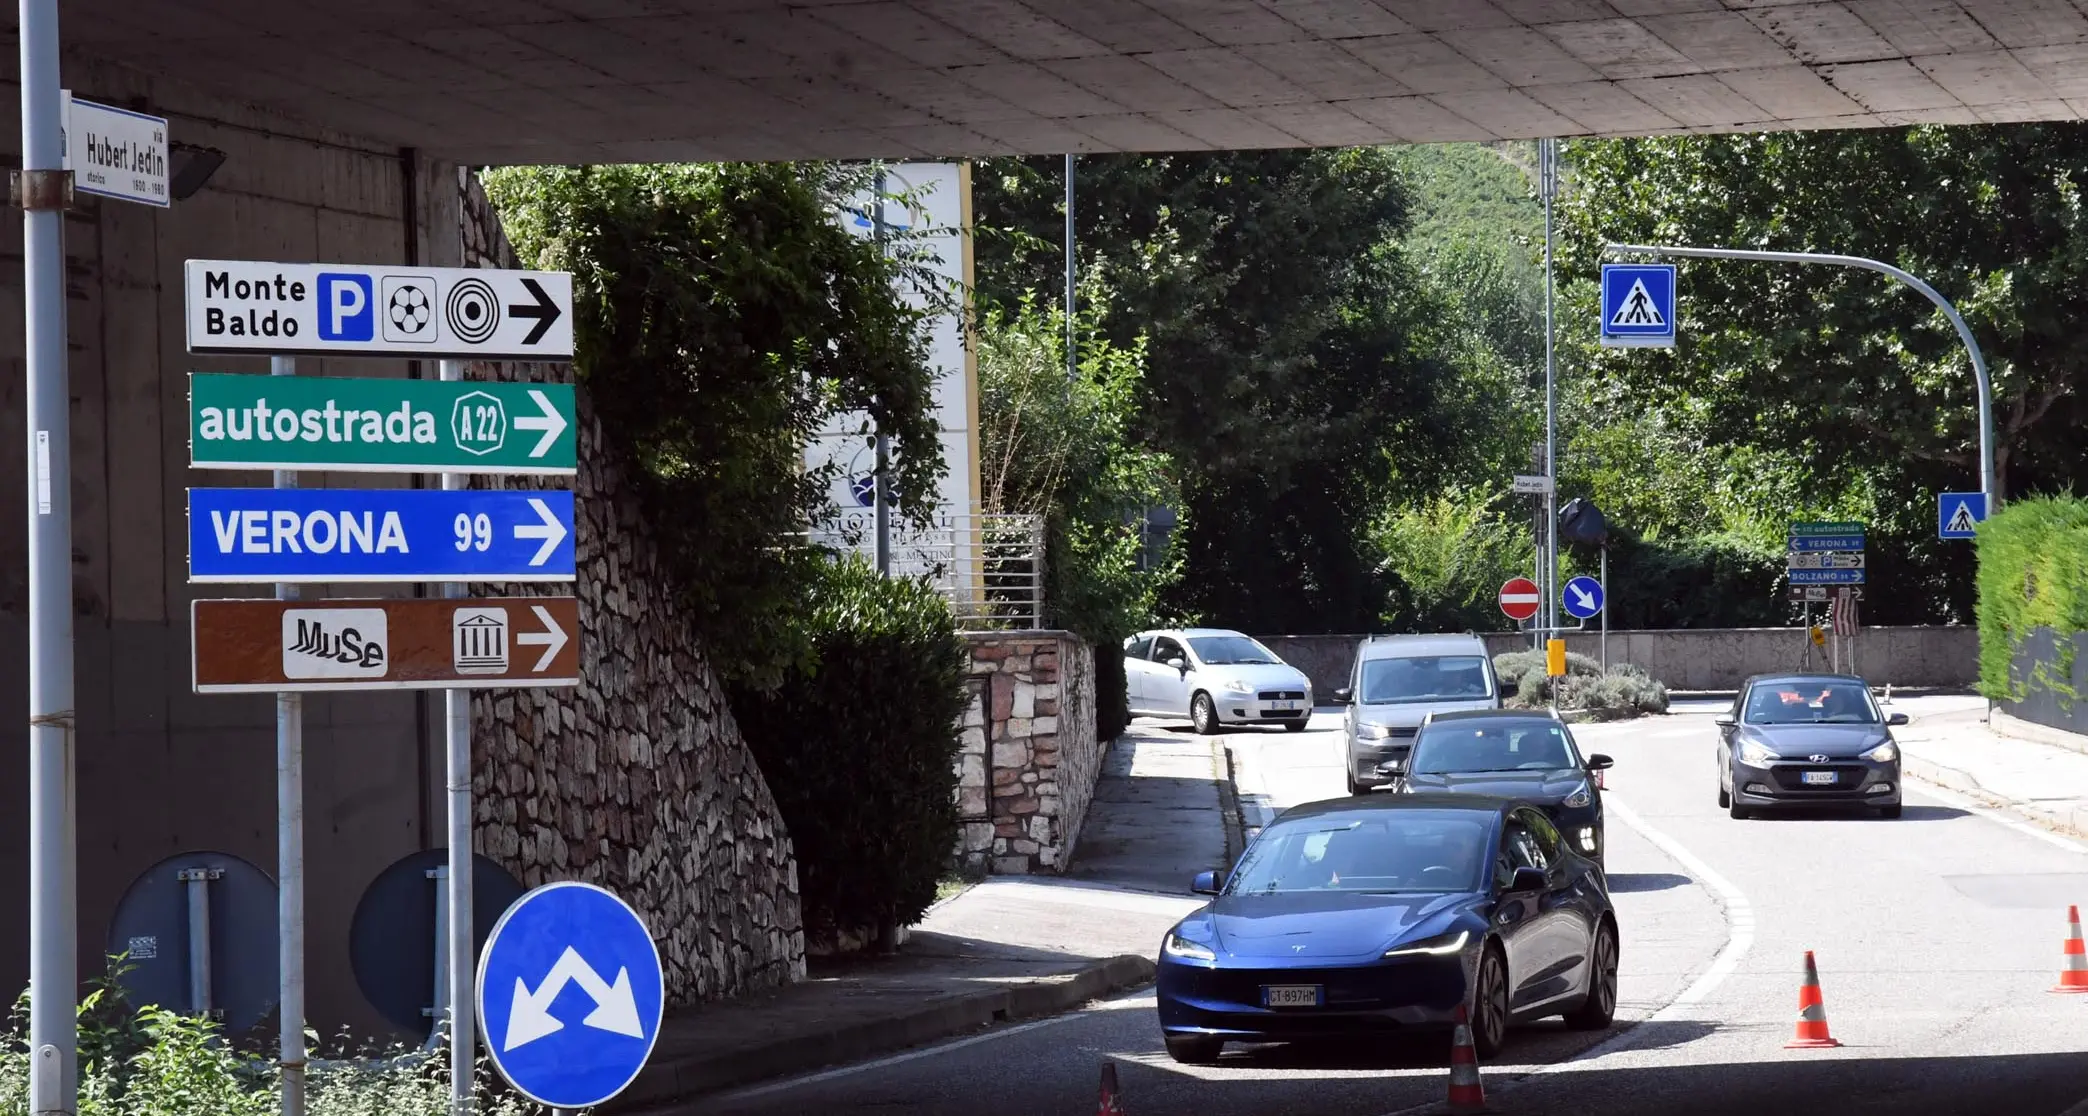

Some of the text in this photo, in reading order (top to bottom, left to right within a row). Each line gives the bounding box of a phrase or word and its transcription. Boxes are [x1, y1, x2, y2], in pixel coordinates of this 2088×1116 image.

[153, 128, 163, 144] via
[86, 132, 164, 177] Hubert Jedin
[205, 271, 306, 302] Monte
[206, 307, 299, 338] Baldo
[199, 398, 437, 444] autostrada
[460, 404, 498, 442] A 22
[211, 510, 492, 554] VERONA 99
[1792, 572, 1837, 580] BOLZANO
